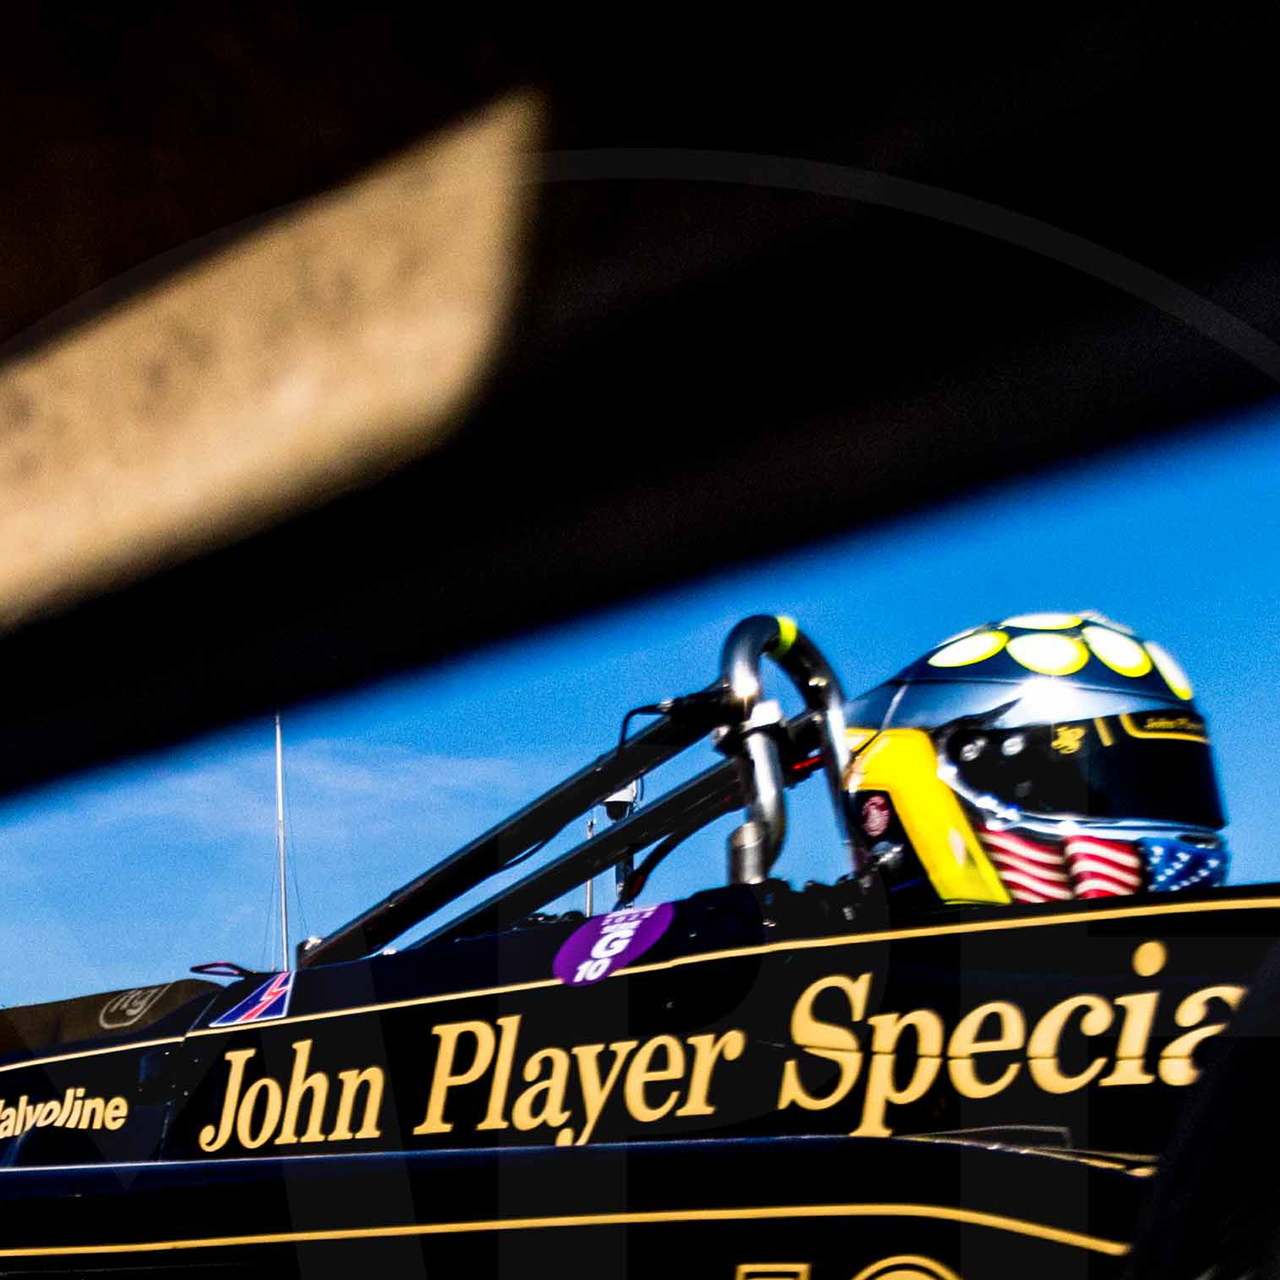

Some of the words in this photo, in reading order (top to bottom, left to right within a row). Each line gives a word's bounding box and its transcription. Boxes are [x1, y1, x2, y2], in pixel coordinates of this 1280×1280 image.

[590, 929, 637, 960] G
[573, 958, 613, 983] 10
[198, 1038, 386, 1153] John
[412, 1016, 745, 1147] Player
[777, 941, 1246, 1138] Specia
